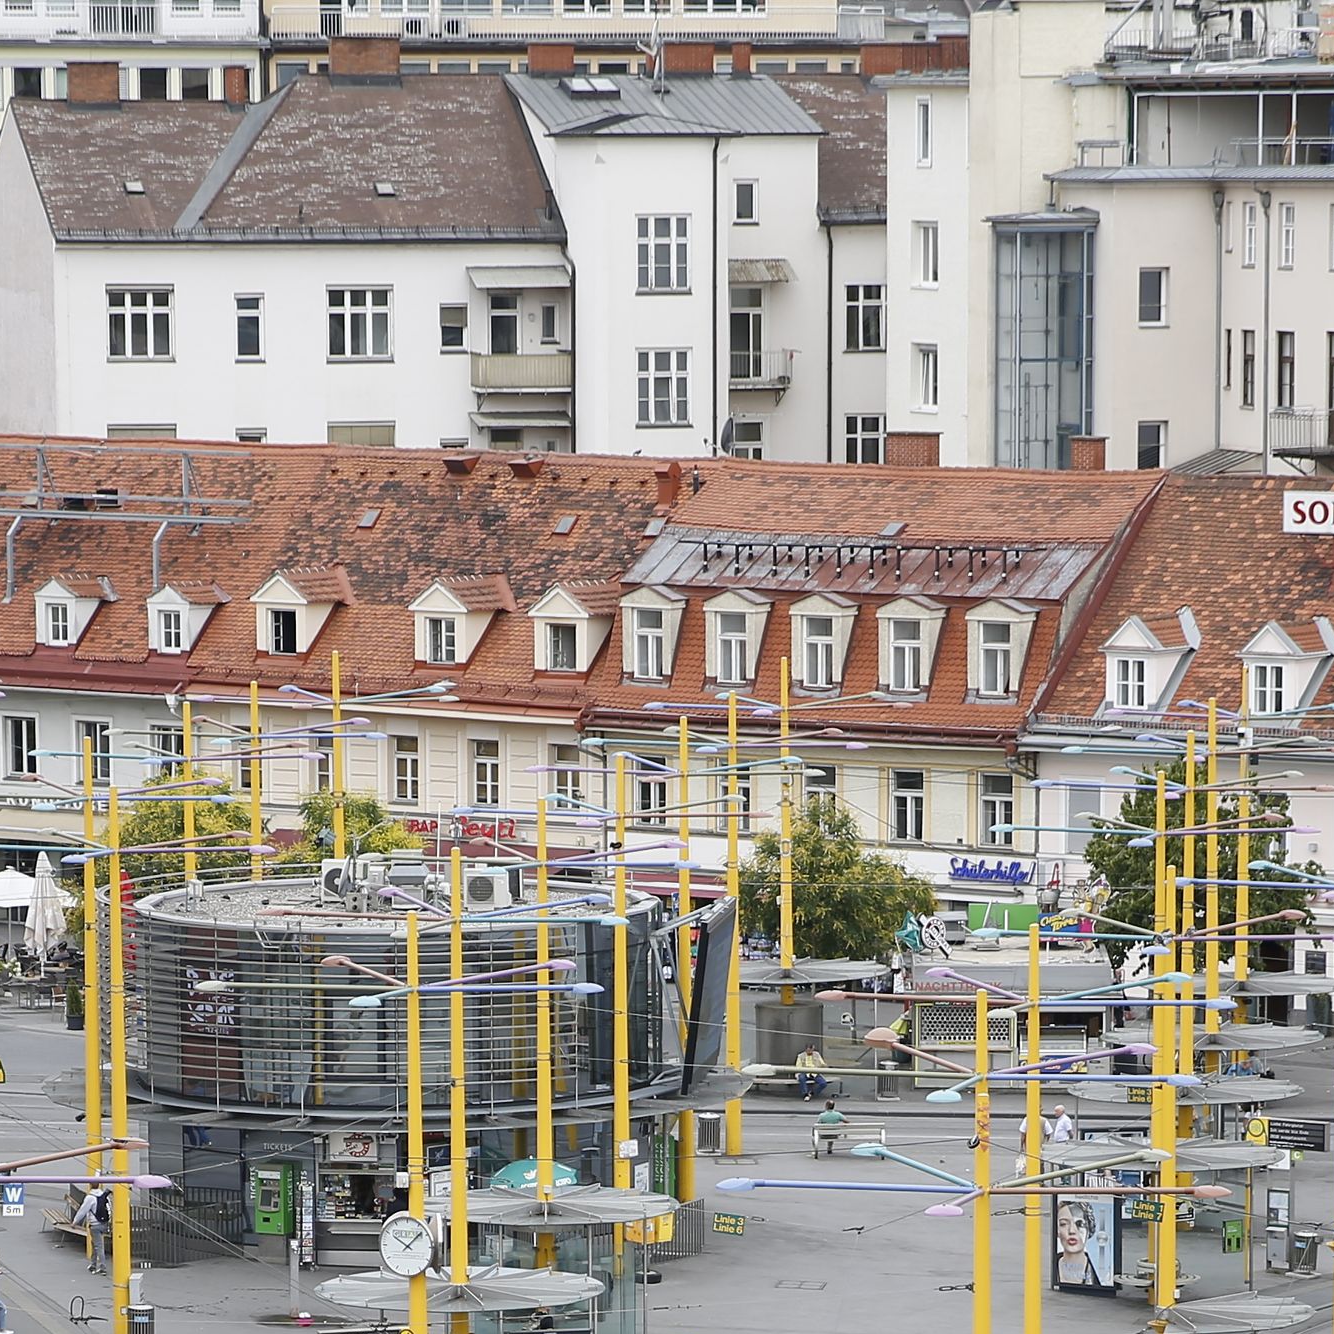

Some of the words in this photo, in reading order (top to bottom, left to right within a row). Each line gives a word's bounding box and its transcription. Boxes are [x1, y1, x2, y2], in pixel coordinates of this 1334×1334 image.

[263, 1143, 293, 1151] TICKETS
[5, 1187, 22, 1202] W
[1134, 1201, 1155, 1211] Linie
[1132, 1210, 1154, 1219] Linie
[714, 1214, 736, 1223] Linie
[737, 1218, 744, 1226] 3
[713, 1223, 735, 1233] Linie
[737, 1226, 743, 1234] 6
